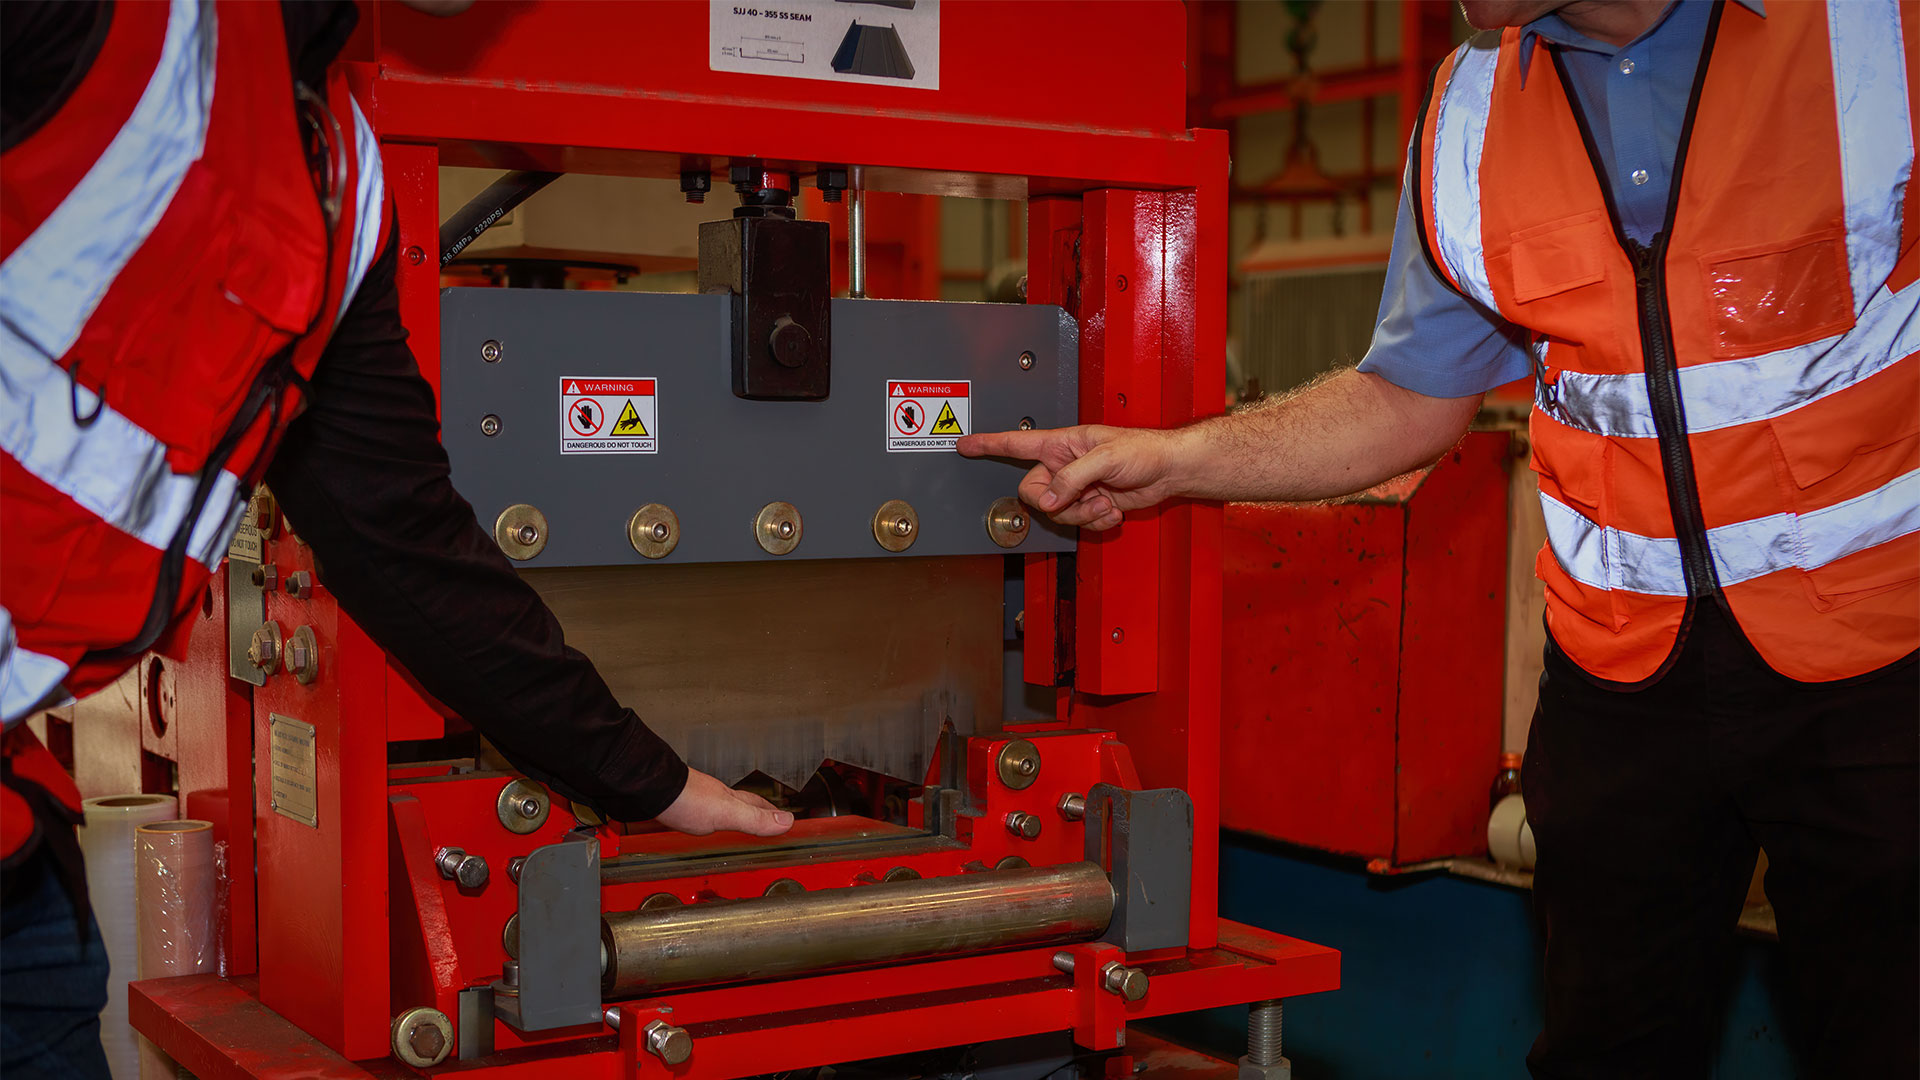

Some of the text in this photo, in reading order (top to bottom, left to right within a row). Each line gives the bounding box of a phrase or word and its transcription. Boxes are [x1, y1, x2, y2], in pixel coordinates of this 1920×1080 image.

[733, 6, 746, 15] SJJ
[747, 8, 758, 17] 40
[764, 10, 778, 18] 355
[779, 12, 789, 20] SS
[790, 13, 812, 22] SEAM
[442, 207, 504, 264] 36.0MPa 5220PSI
[584, 384, 634, 392] WARNING
[907, 386, 951, 394] WARNING
[567, 441, 652, 449] DANGEROUS DO NOT TOUCH
